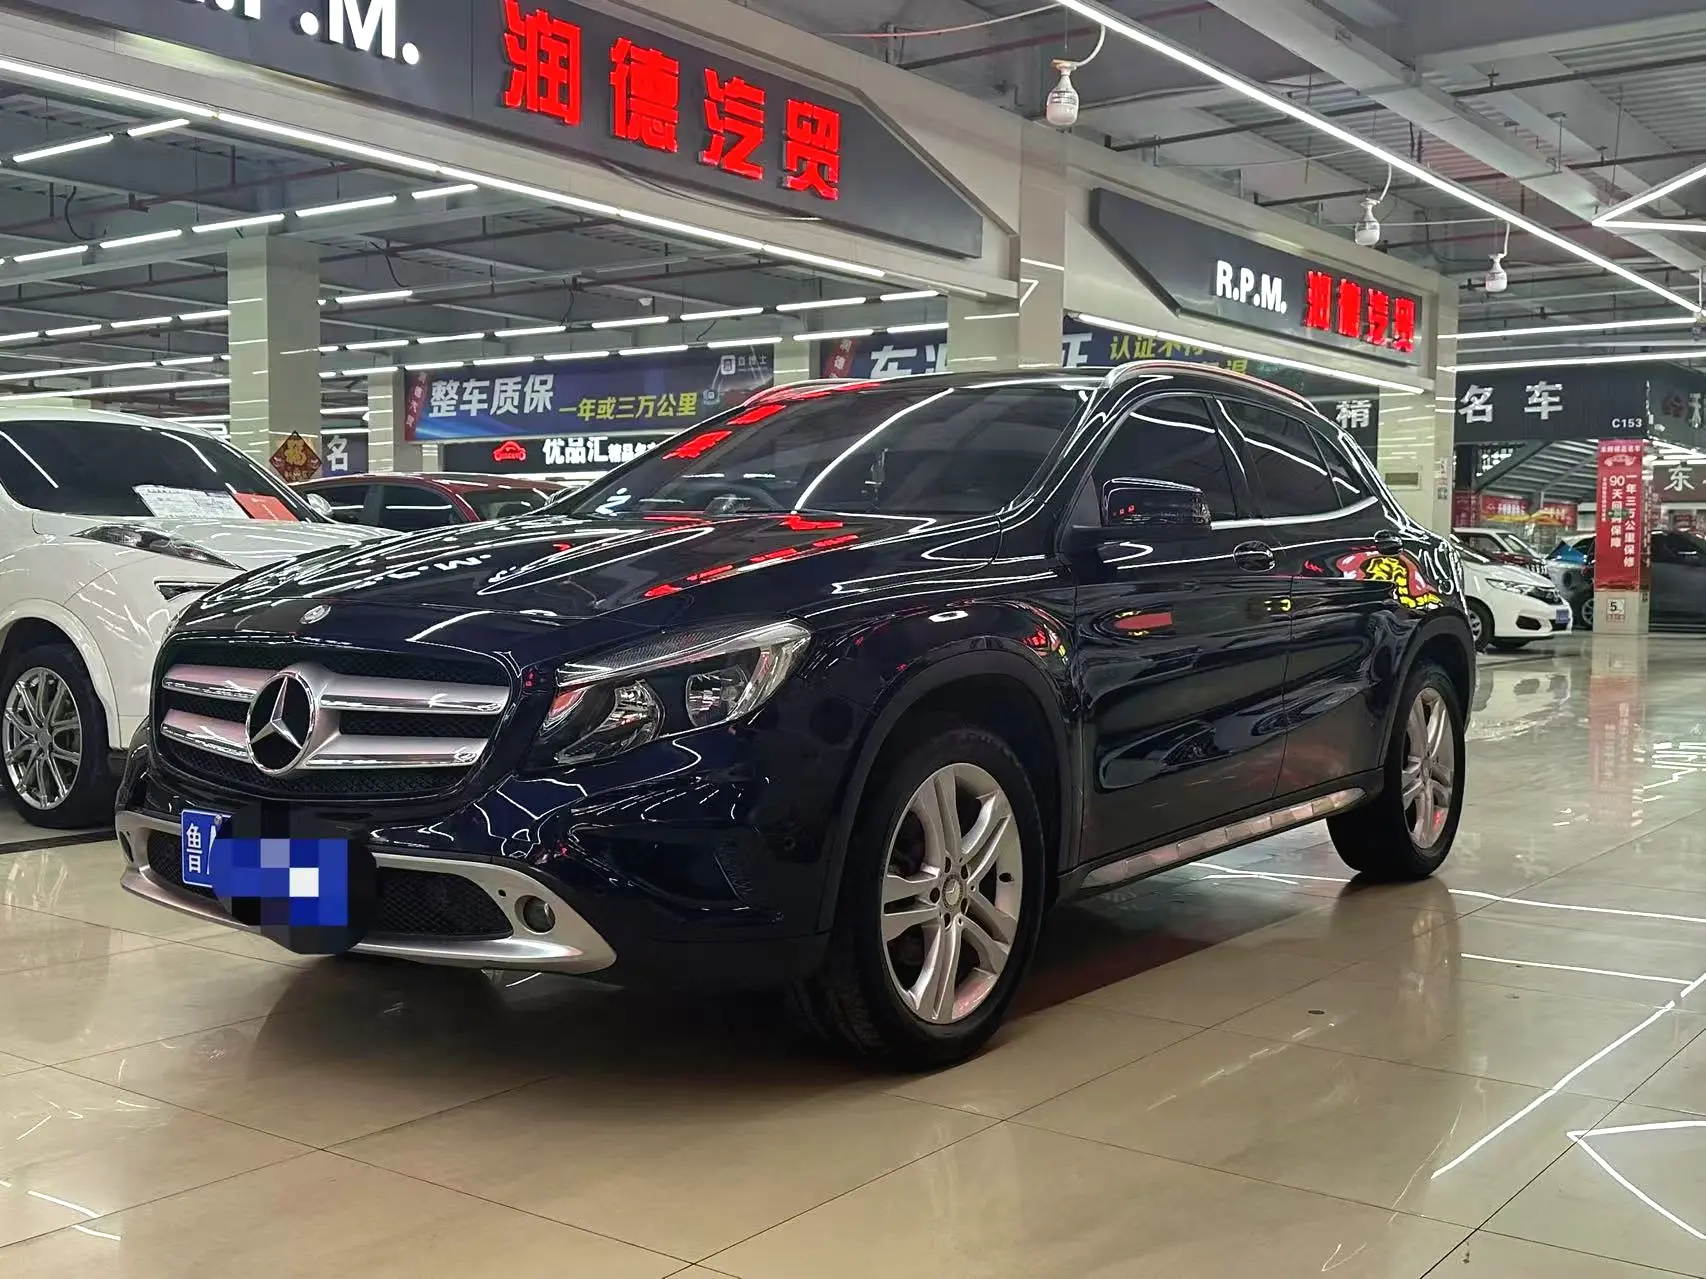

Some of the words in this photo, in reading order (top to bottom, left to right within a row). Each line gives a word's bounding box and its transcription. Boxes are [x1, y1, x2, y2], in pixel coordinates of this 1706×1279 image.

[502, 0, 841, 200] 润德汽贸
[1216, 260, 1288, 314] R.P.M.
[429, 374, 554, 418] 整车质保
[559, 392, 698, 421] 一年或三万公里
[1458, 381, 1564, 424] 名车
[1611, 418, 1642, 428] C153
[327, 435, 349, 472] 名
[542, 436, 608, 465] 优品汇
[1664, 465, 1696, 492] 东
